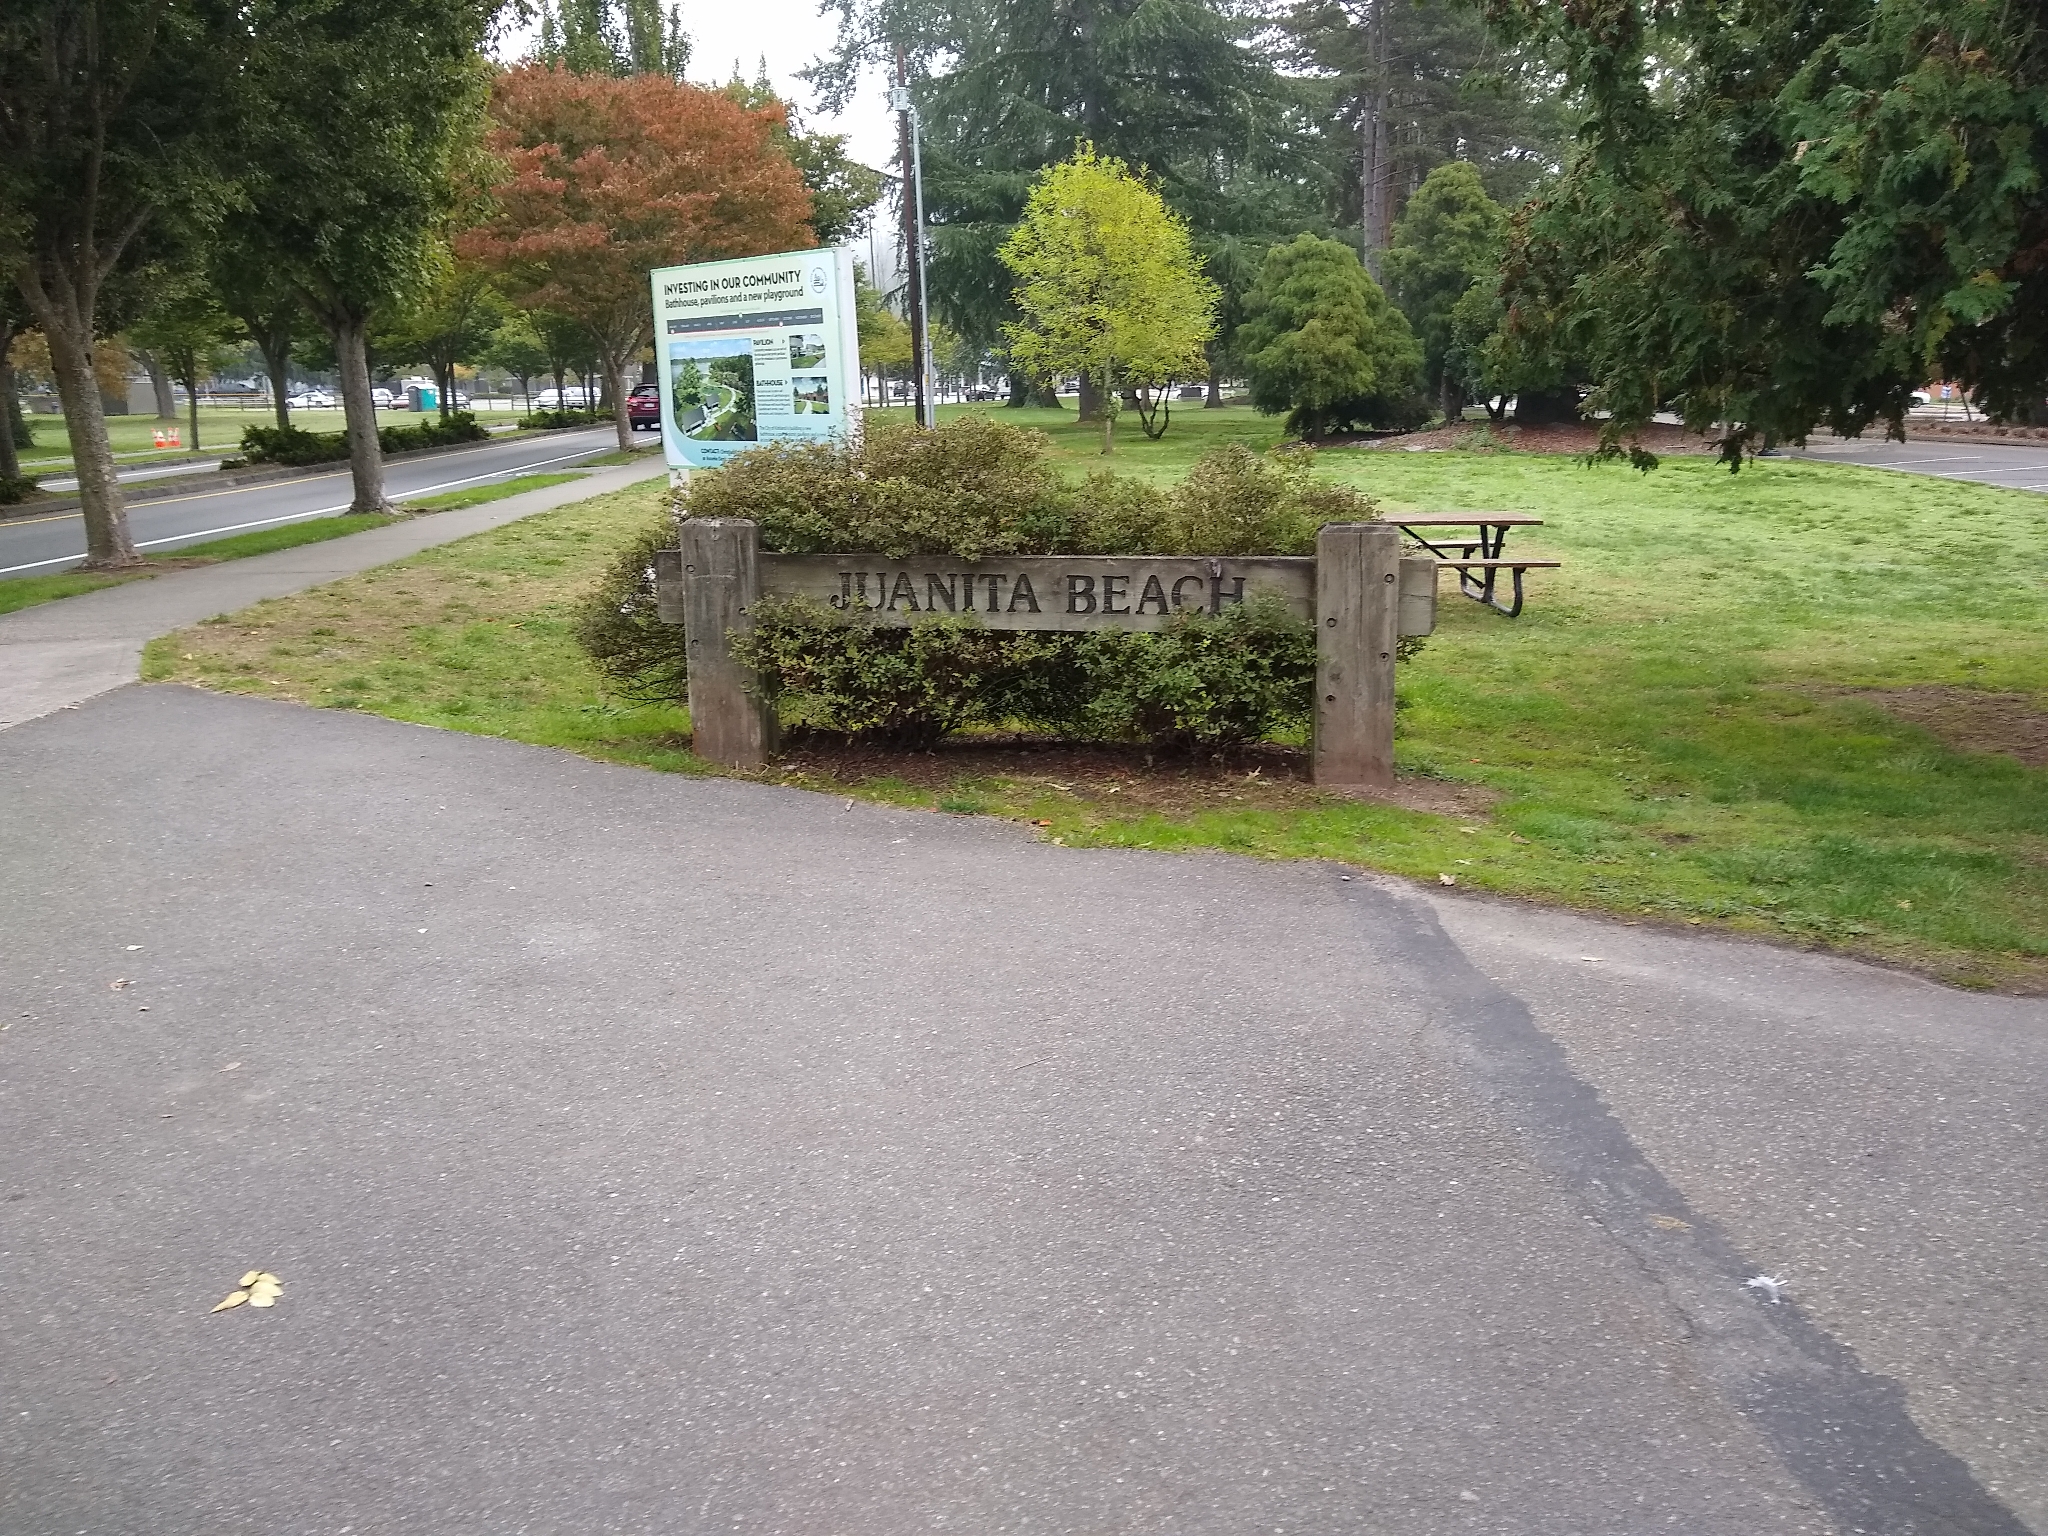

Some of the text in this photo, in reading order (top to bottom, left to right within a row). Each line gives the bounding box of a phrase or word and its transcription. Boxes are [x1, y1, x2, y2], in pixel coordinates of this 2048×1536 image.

[664, 270, 801, 295] INVESTING IN OUR COMMUNITY
[730, 292, 742, 303] and
[748, 292, 763, 301] new
[764, 286, 804, 303] playground
[831, 572, 1247, 616] JUANITA BEACH
